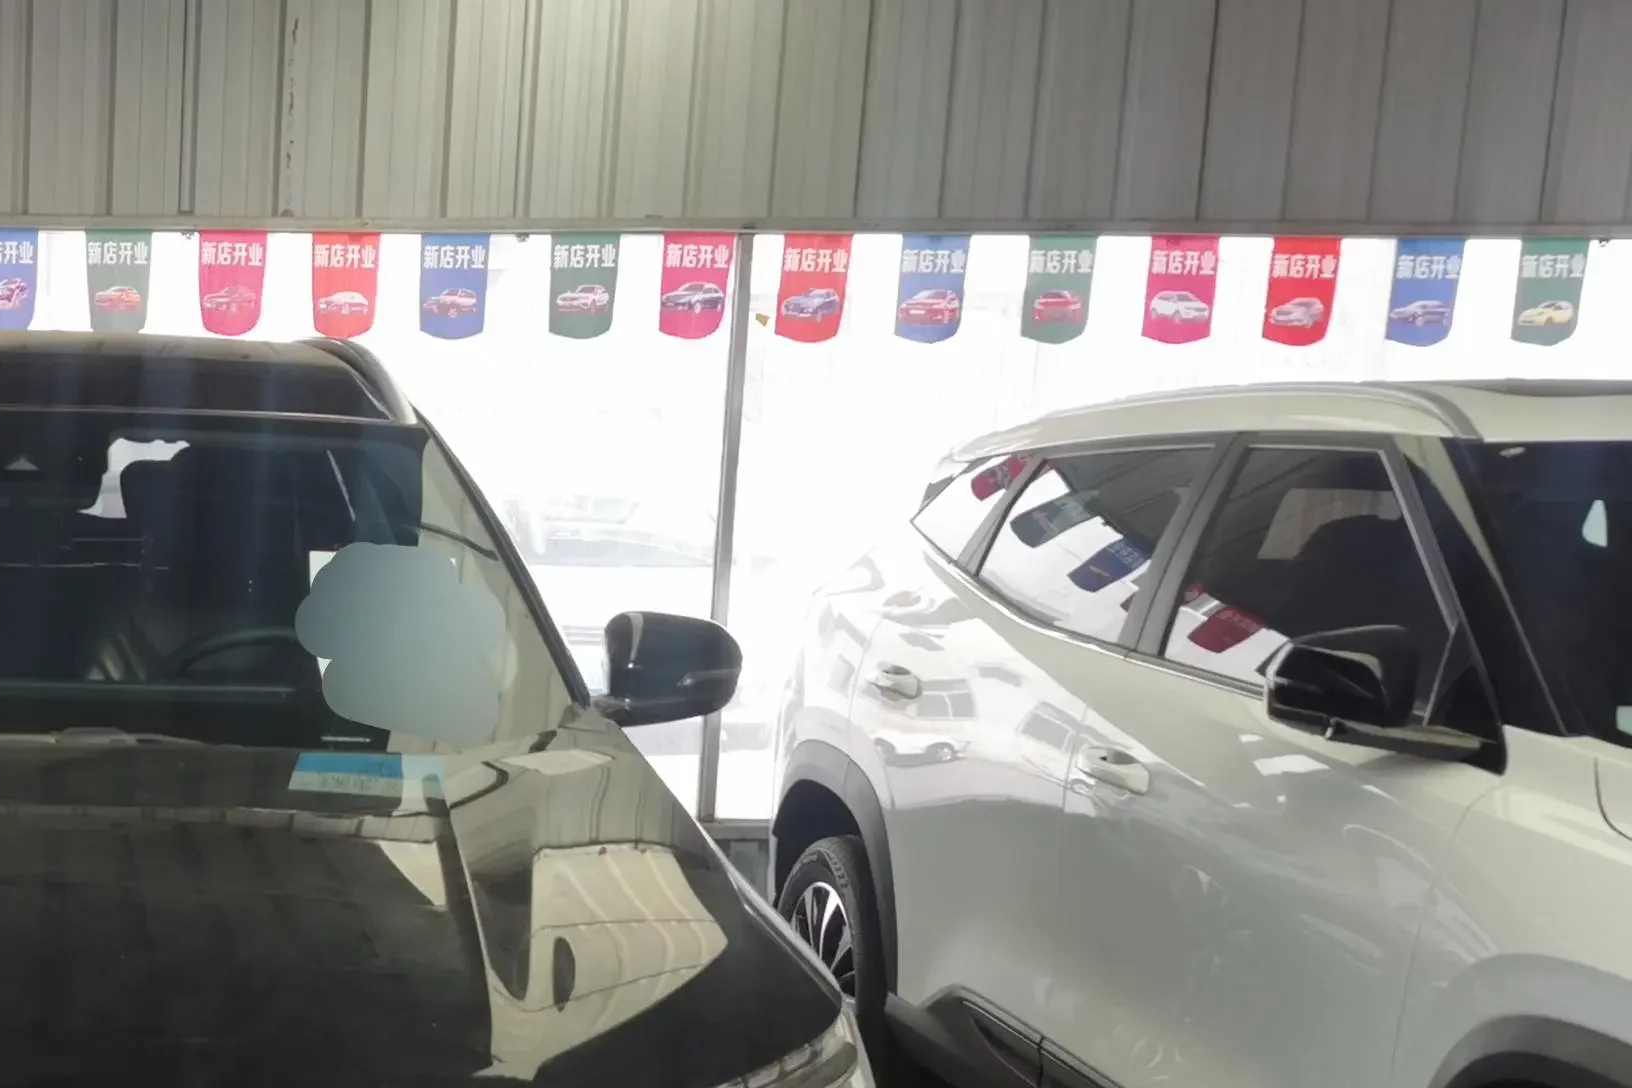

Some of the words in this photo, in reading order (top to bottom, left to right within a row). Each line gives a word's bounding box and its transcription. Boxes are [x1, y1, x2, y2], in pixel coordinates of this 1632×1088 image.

[88, 241, 148, 264] 新店开业
[201, 242, 263, 265] 新店开业
[314, 244, 376, 268] 新店开业
[424, 245, 485, 269] 新店开业
[554, 244, 616, 268] 新店开业
[666, 244, 729, 268] 新店开业
[784, 249, 848, 272] 新店开业
[903, 250, 965, 273] 新店开业
[1029, 250, 1093, 273] 新店开业
[1152, 250, 1215, 275] 新店开业
[1273, 254, 1337, 278] 新店开业
[1397, 255, 1459, 279] 新店开业
[1521, 255, 1586, 278] 新店开业
